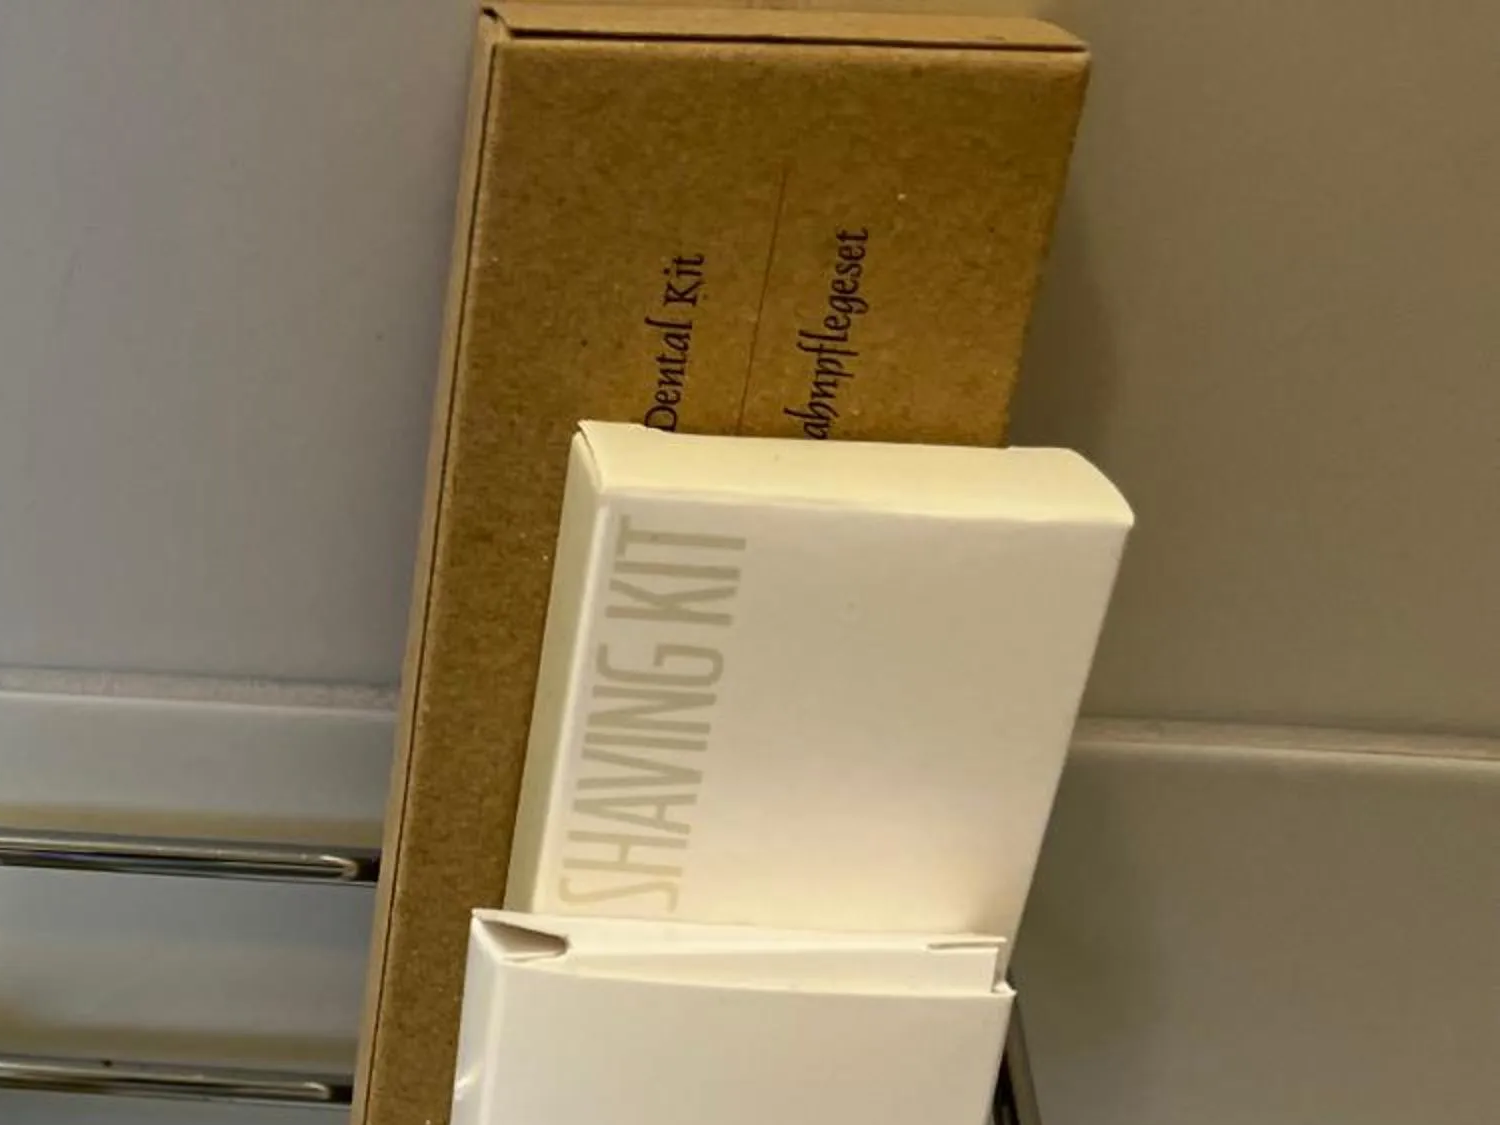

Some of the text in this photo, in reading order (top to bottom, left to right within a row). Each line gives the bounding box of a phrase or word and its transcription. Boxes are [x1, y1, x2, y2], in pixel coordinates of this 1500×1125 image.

[644, 253, 705, 432] Dental Kit
[783, 227, 869, 441] ahnpflegeset
[558, 515, 747, 913] SHAVING KIT
